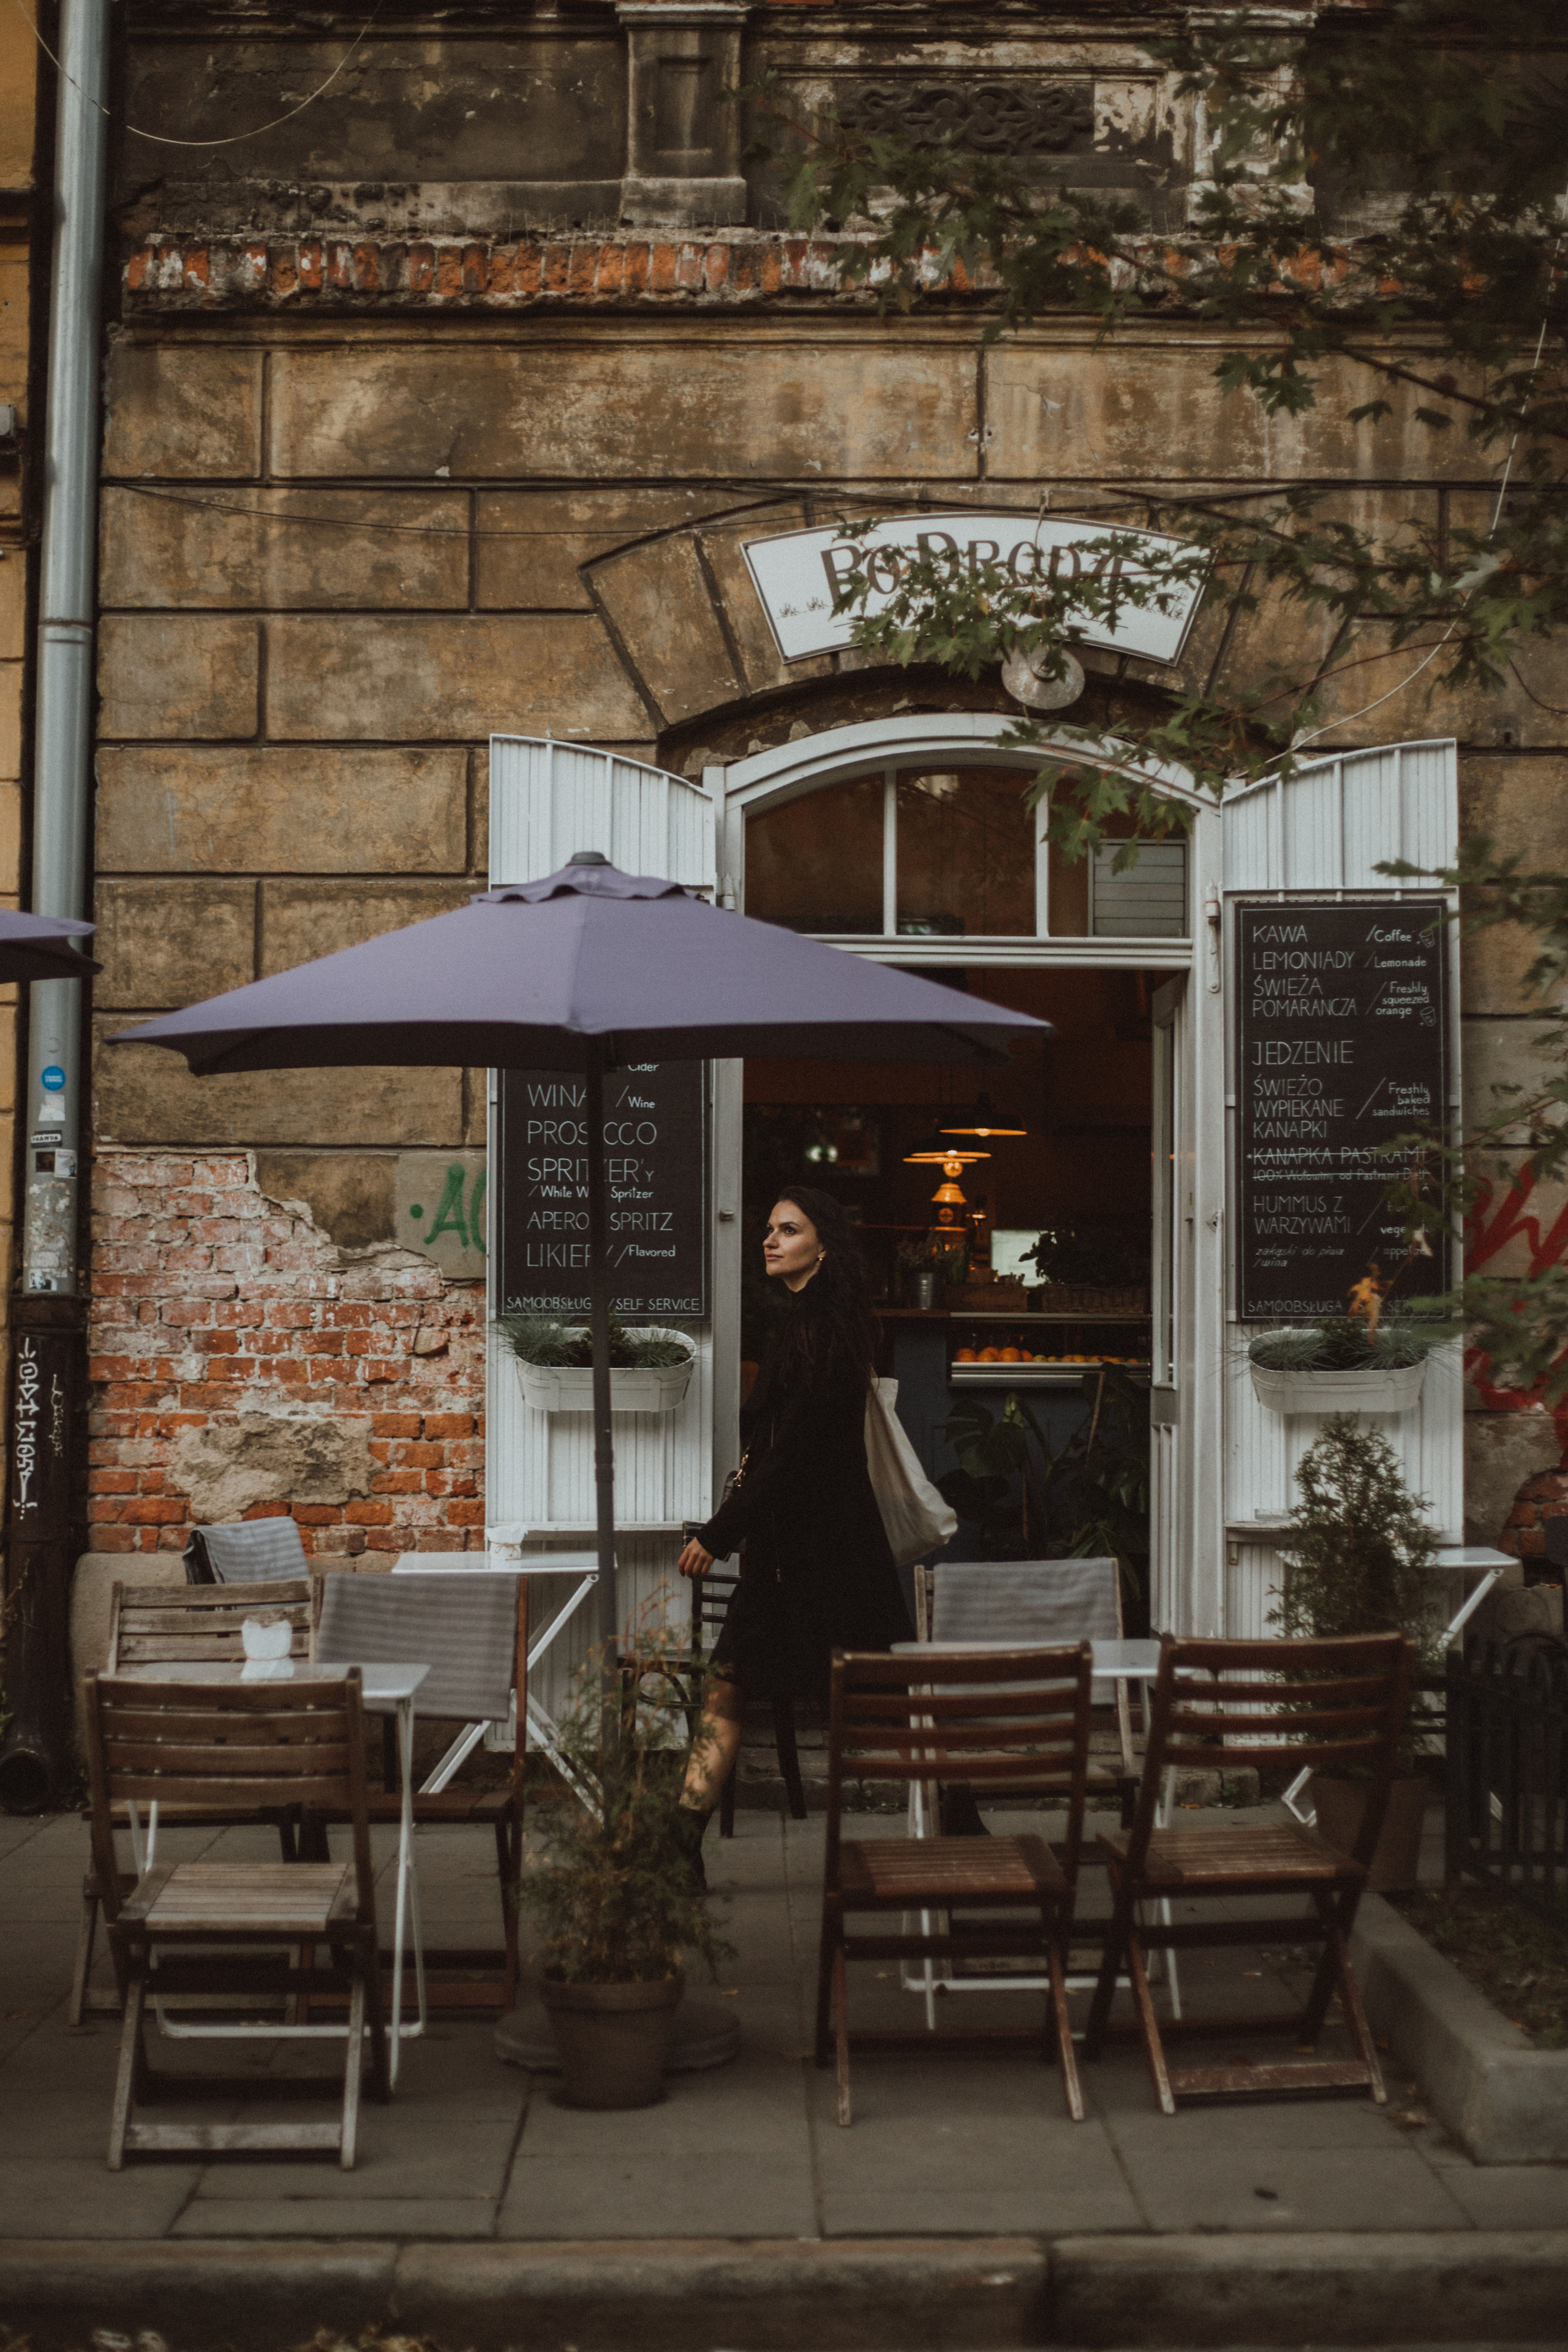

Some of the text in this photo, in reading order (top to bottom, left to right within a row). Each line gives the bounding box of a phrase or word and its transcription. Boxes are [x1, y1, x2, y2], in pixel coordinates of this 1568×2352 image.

[1253, 925, 1308, 943] KAWA
[1253, 951, 1355, 970] LEMONIADY
[1253, 974, 1428, 997] ŚWIEŻA Freshly
[1382, 994, 1429, 1006] squeezed
[1376, 1006, 1412, 1019] orange
[1251, 1041, 1354, 1065] JEDZENIE
[1253, 1073, 1430, 1096] ŚWIEŻO Freshly
[1253, 1095, 1430, 1117] WYPIEKANE baked
[1372, 1105, 1430, 1117] sandwiches
[527, 1121, 657, 1145] PROSCCO
[1253, 1120, 1327, 1139] KANAPKI
[1253, 1147, 1333, 1165] KANAPKA
[527, 1158, 655, 1183] SPRITER'Y
[610, 1186, 654, 1202] Spritzer
[1253, 1196, 1343, 1213] HUMMUS Z
[527, 1212, 673, 1231] APERO SPRITZ
[1254, 1216, 1351, 1234] WARZYWAMI
[527, 1243, 613, 1267] LIKIE
[1302, 1245, 1316, 1256] do
[506, 1297, 592, 1310] SAMOOBSŁUG
[649, 1298, 700, 1311] SERVICE
[1248, 1299, 1343, 1313] SAMOOBSŁUGA
